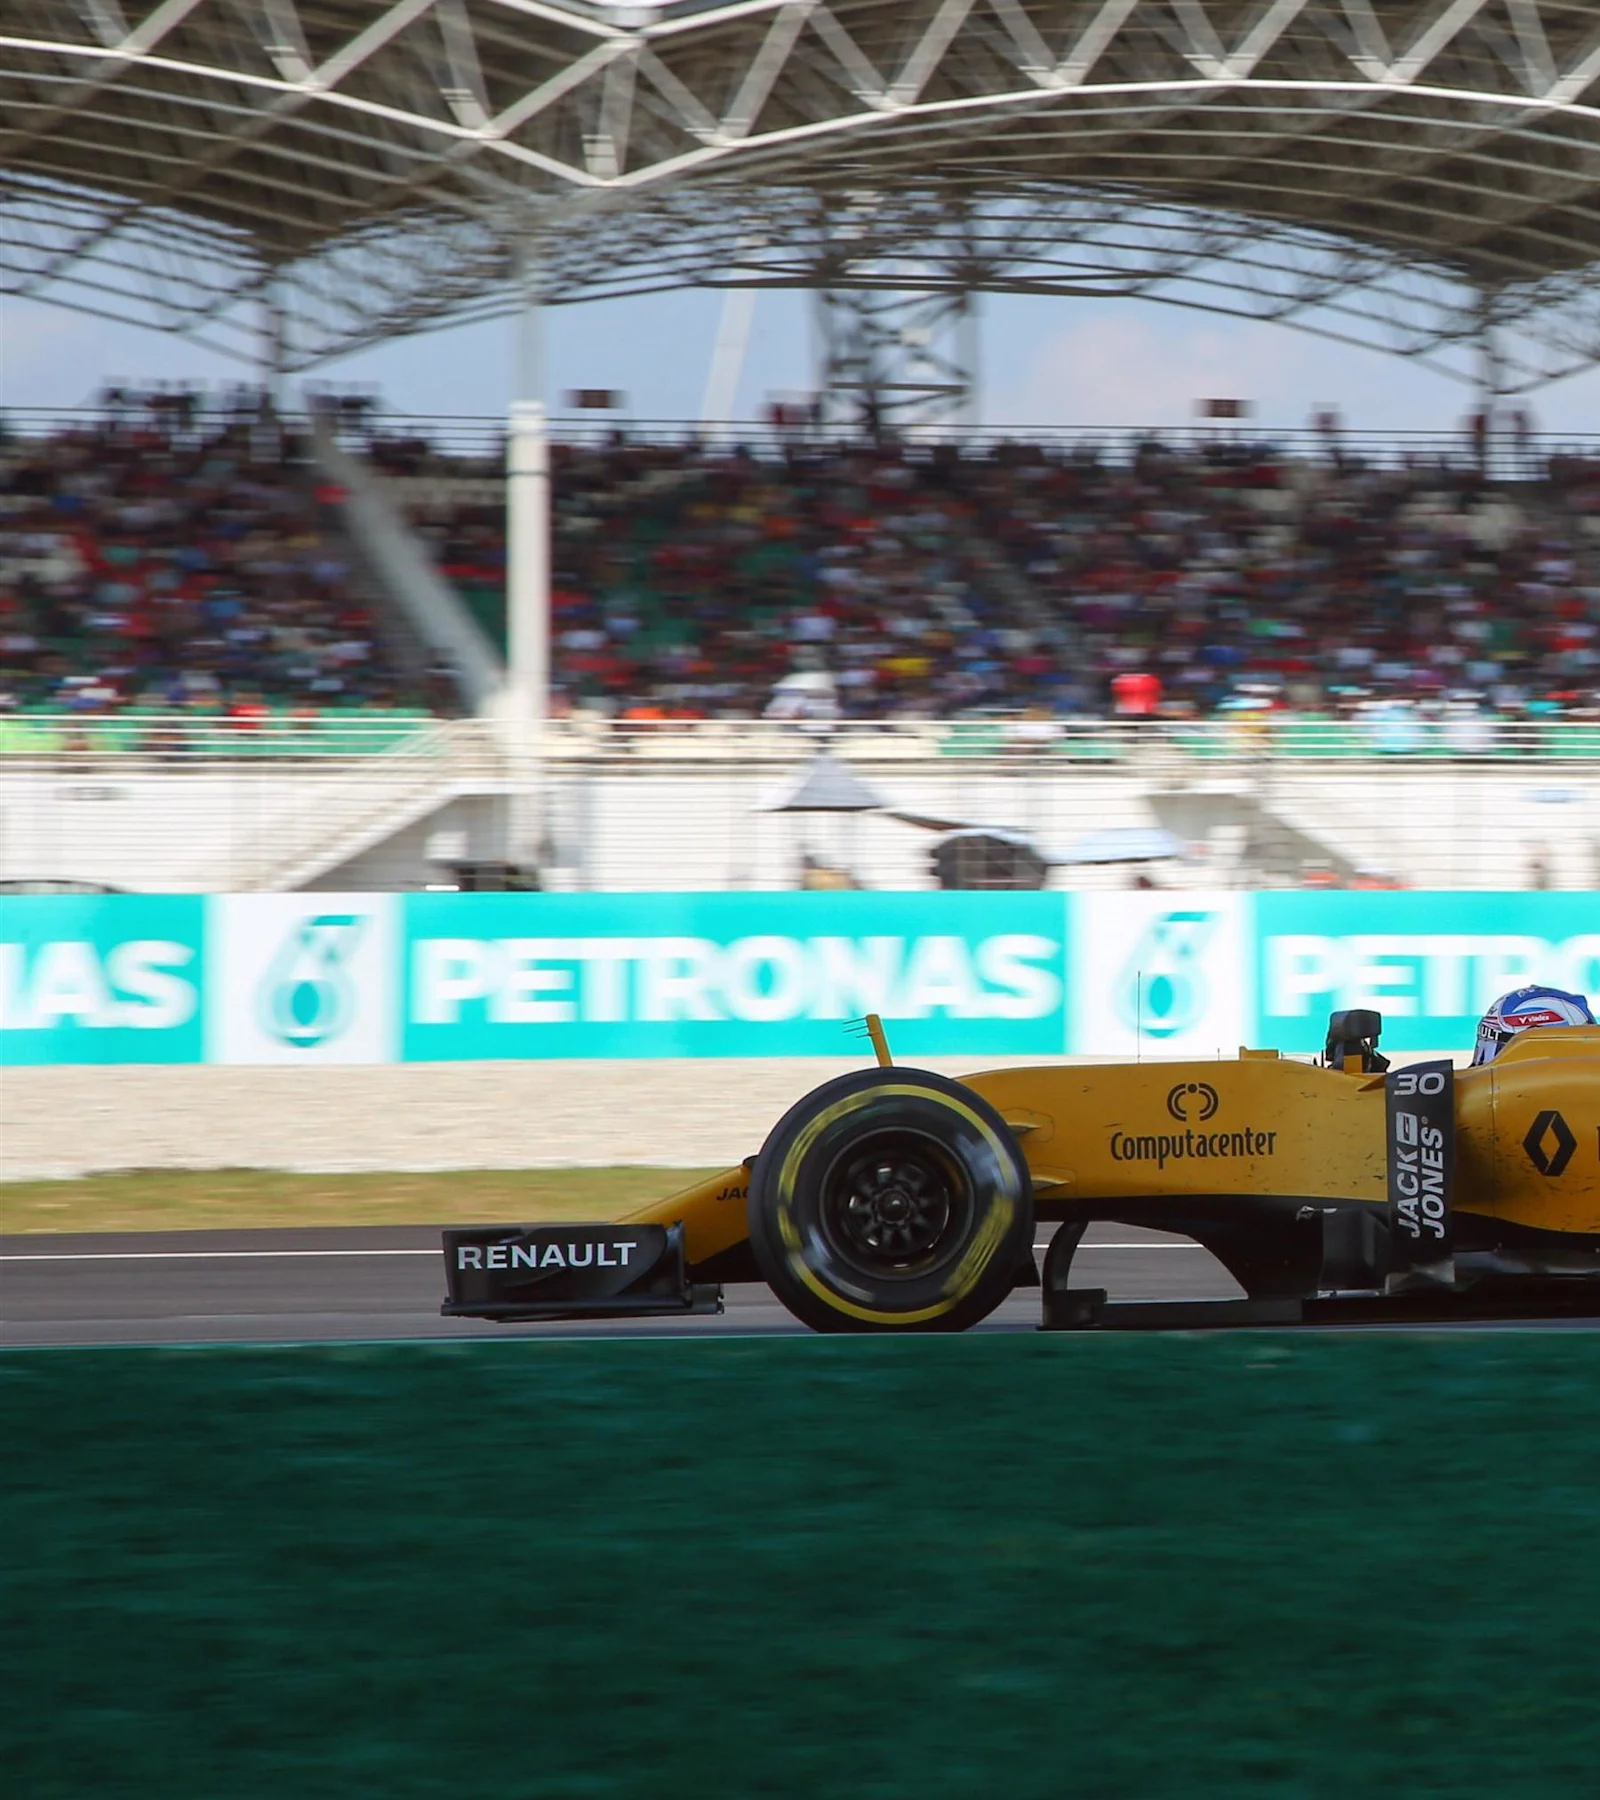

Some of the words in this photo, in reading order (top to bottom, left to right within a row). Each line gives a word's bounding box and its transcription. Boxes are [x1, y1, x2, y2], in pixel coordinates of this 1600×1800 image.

[408, 935, 1064, 1024] PETRONAS
[1479, 1025, 1502, 1041] ULT
[1394, 1072, 1446, 1096] 30
[1110, 1127, 1277, 1170] Computacenter
[1396, 1146, 1421, 1238] JACK
[457, 1242, 637, 1270] RENAULT
